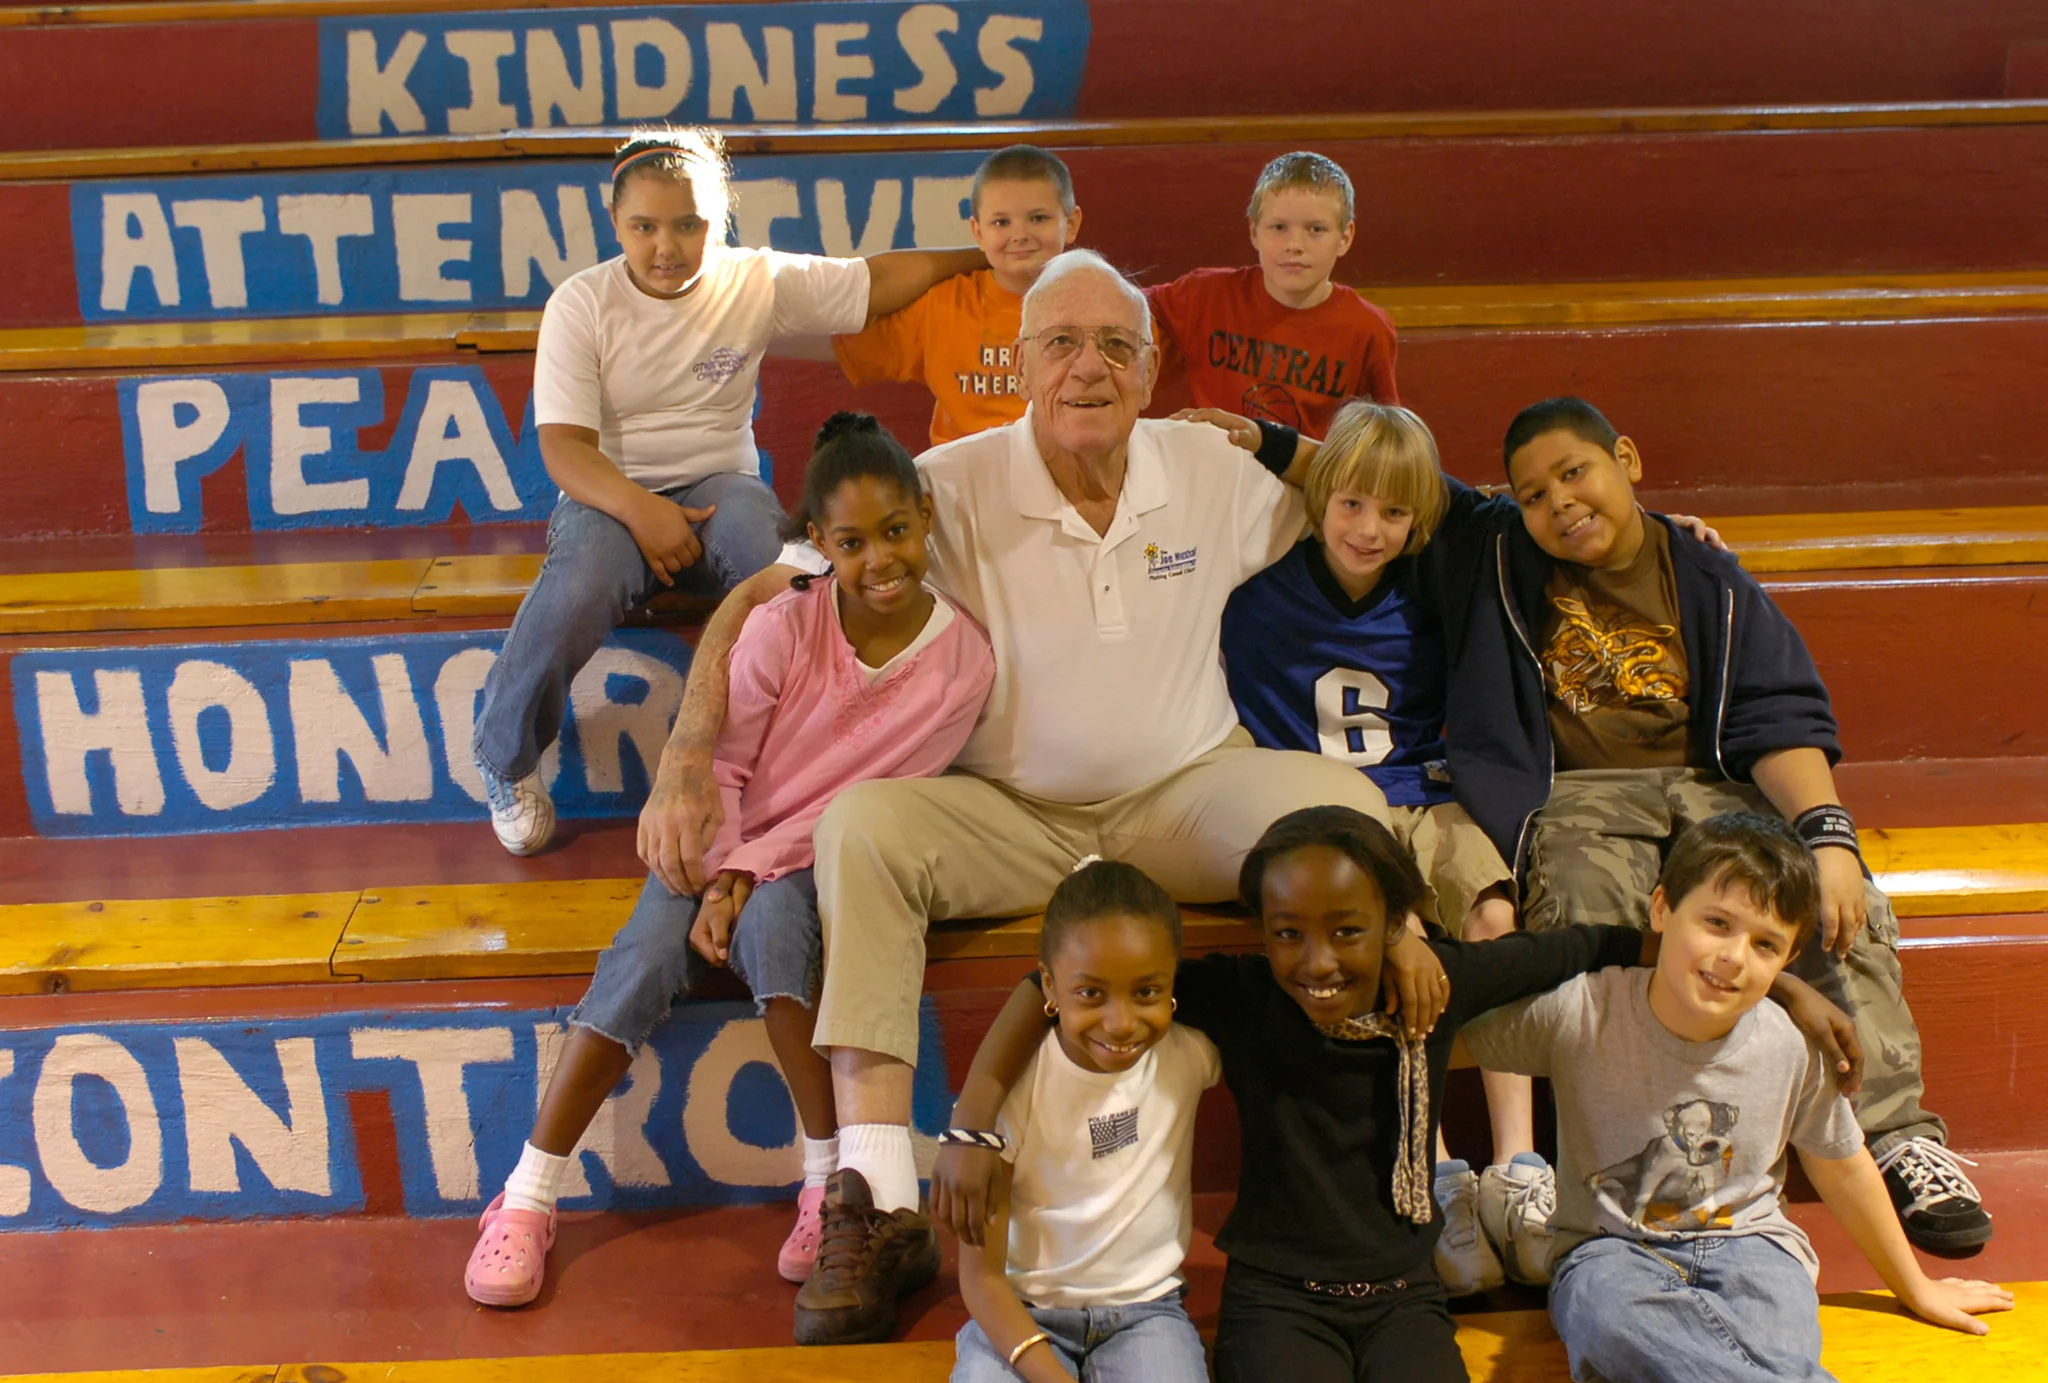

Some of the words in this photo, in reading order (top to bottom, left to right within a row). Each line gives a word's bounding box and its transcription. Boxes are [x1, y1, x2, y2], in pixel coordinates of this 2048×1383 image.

[346, 4, 1043, 136] KINDNESS
[1209, 329, 1347, 398] CENTRAL
[136, 377, 523, 516] PEA
[35, 647, 686, 816] HONOR
[1315, 667, 1395, 769] 6
[0, 1018, 944, 1215] ONTRO
